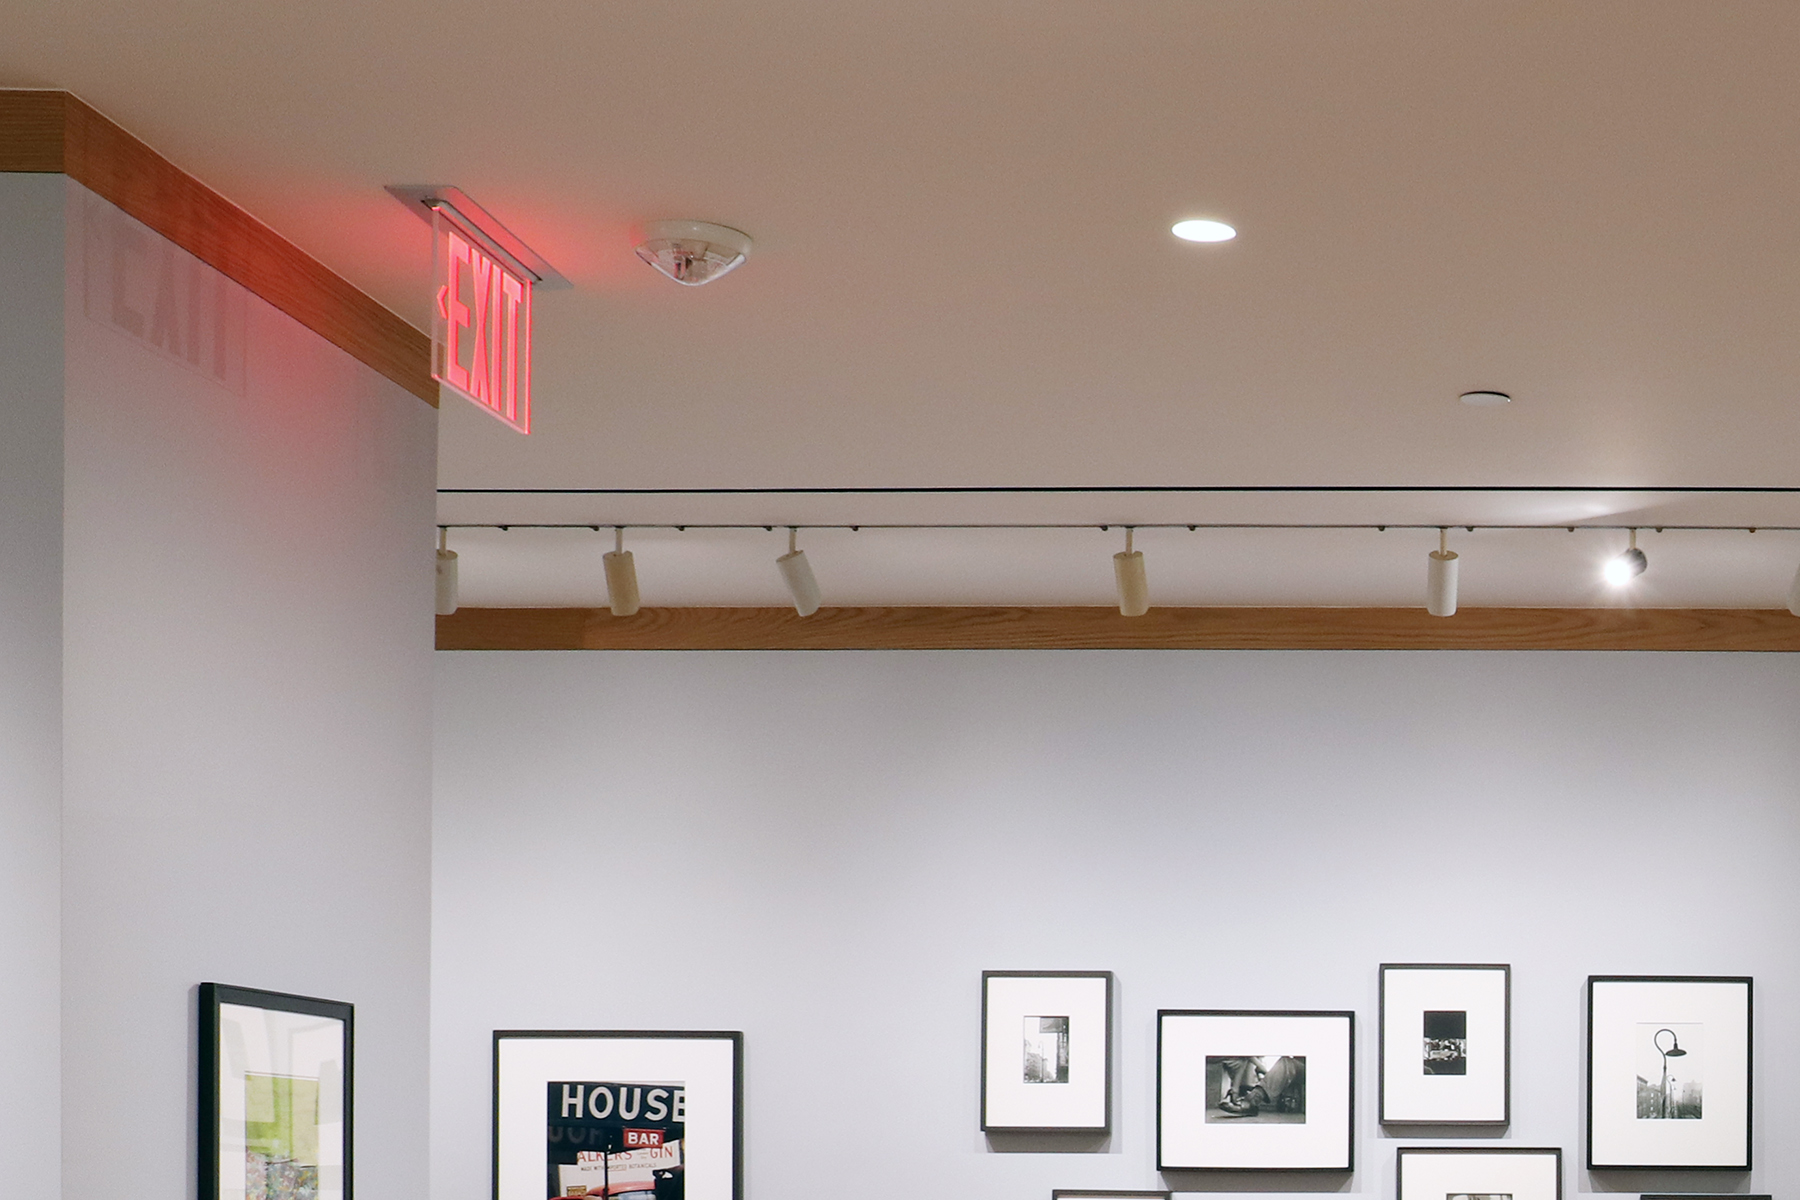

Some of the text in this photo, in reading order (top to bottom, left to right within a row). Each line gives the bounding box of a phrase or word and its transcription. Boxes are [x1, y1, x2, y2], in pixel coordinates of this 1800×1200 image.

[447, 231, 524, 421] EXIT
[561, 1084, 685, 1122] HOUSE
[628, 1132, 659, 1145] BAR
